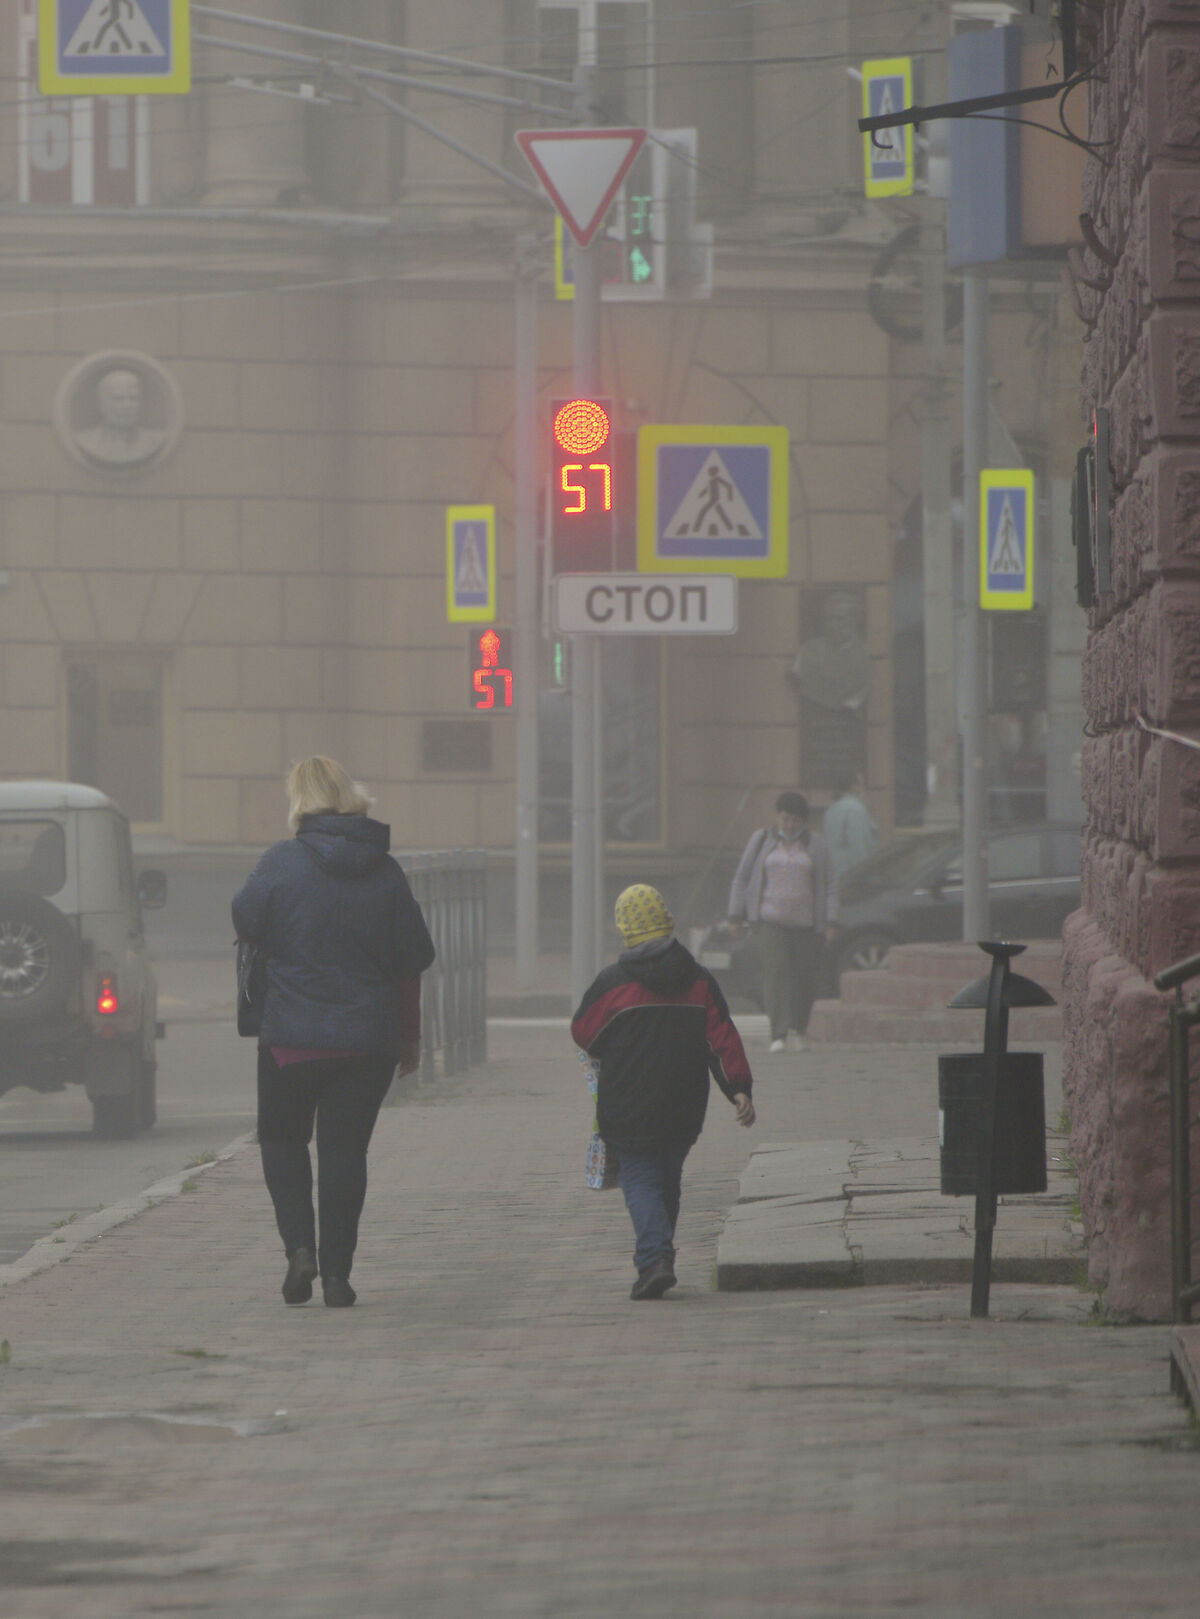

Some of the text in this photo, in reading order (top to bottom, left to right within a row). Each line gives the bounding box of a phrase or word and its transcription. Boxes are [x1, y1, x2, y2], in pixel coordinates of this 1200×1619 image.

[560, 463, 612, 514] 57
[585, 585, 707, 622] СТОП
[473, 668, 513, 709] 57
